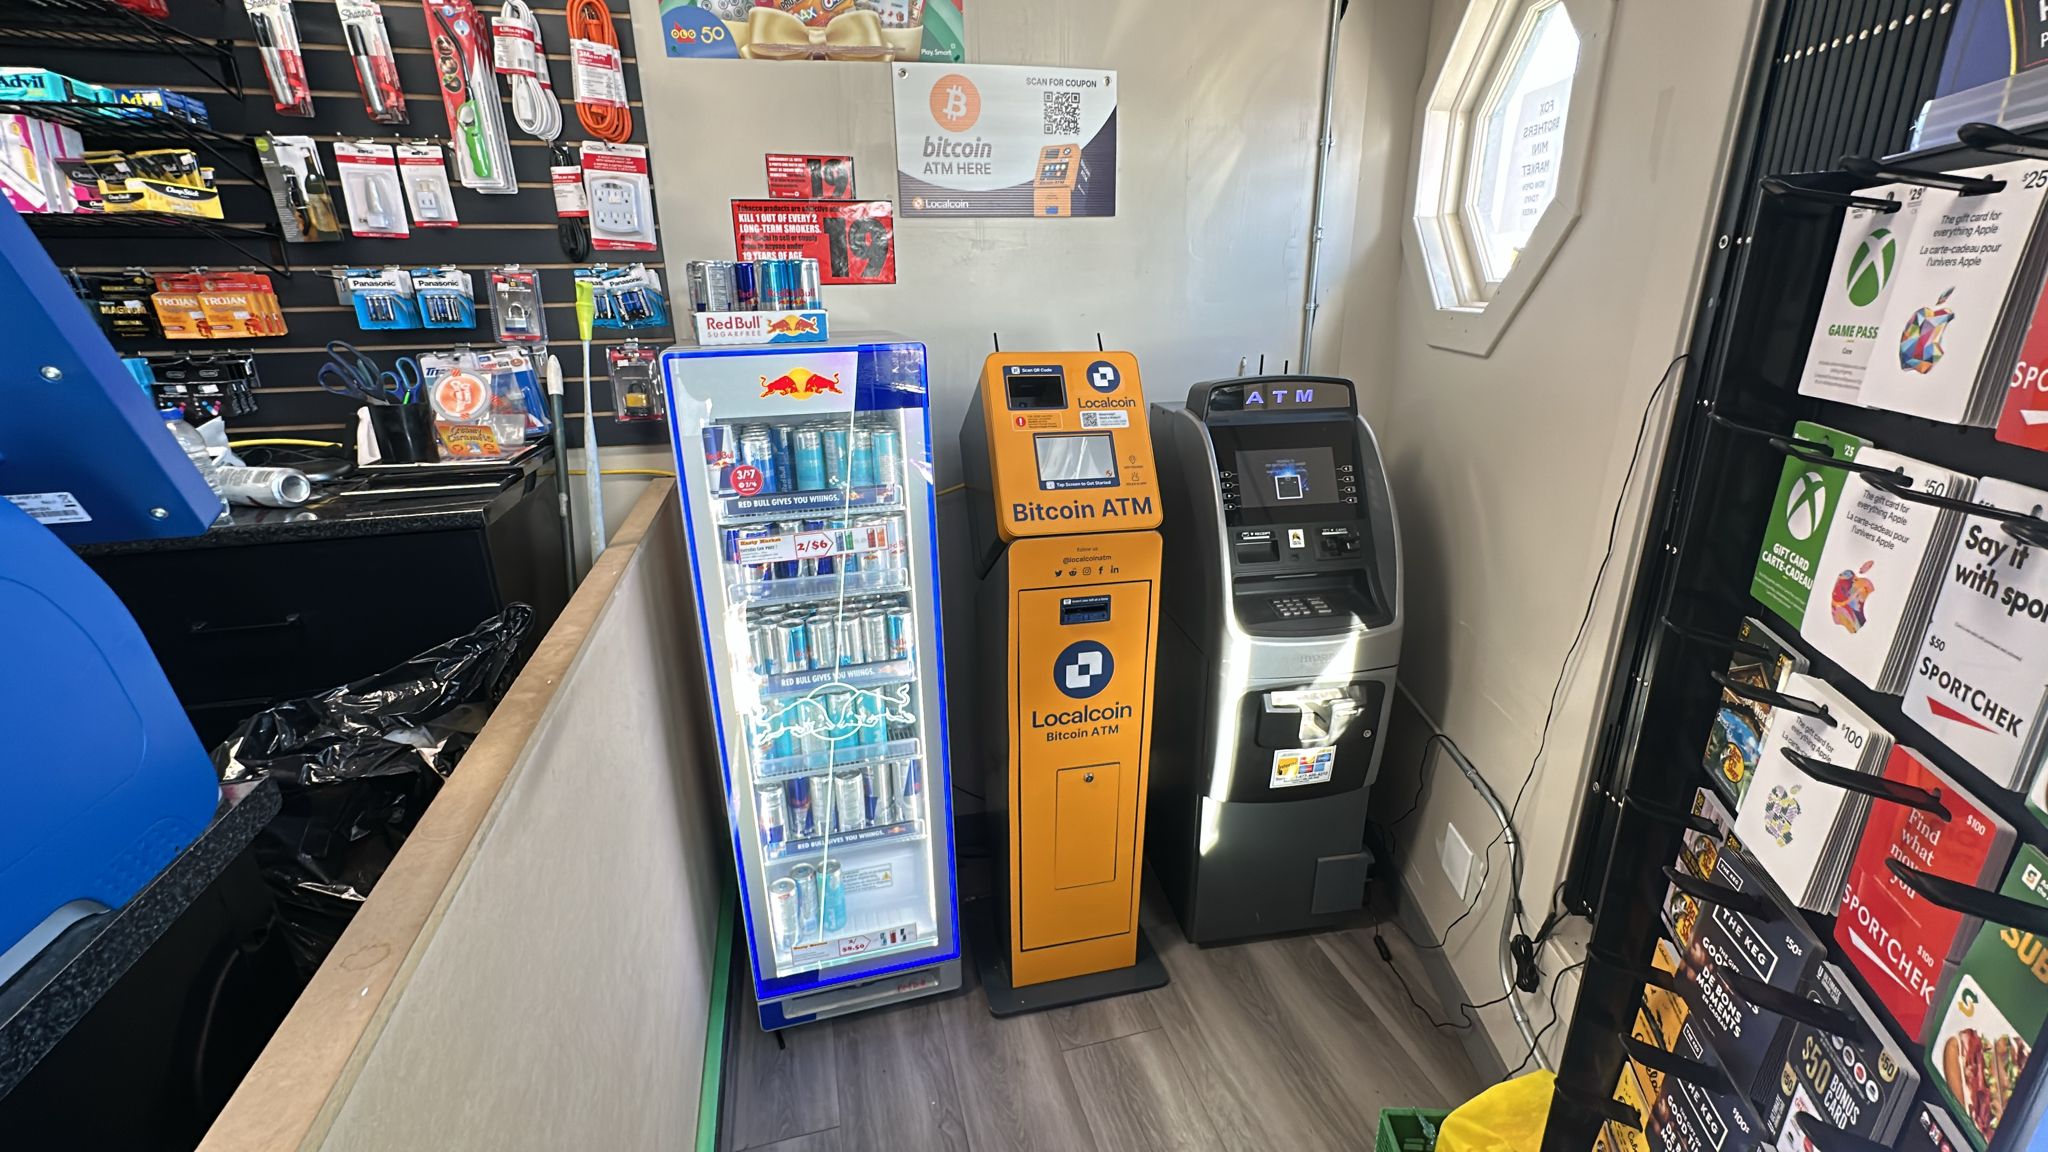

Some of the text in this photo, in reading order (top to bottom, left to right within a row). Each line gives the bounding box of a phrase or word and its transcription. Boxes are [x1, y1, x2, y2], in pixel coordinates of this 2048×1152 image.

[671, 29, 697, 40] OLG
[700, 26, 725, 44] 50
[0, 75, 45, 89] Advil
[1026, 77, 1097, 88] SCAN FOR COUPON
[922, 136, 992, 158] bitcoin
[806, 158, 849, 198] 19
[923, 162, 992, 175] ATM HERE
[2022, 170, 2048, 190] $25
[165, 186, 200, 197] ChapStick
[925, 199, 969, 209] Localcoin
[738, 214, 817, 223] KILL 1 OUT OF EVERY 2
[1941, 211, 2002, 226] The gift card for
[739, 224, 821, 234] LONG-TERM SMOKERS.
[1933, 225, 1999, 238] everything Apple
[742, 252, 752, 260] 19
[752, 252, 776, 260] YEARS
[823, 217, 888, 278] 19
[1920, 244, 2002, 256] La carte-cadeau pour
[1958, 256, 1982, 267] Apple
[352, 279, 397, 288] Panasonic
[418, 279, 460, 288] Panasonic
[609, 276, 643, 287] Panasonic
[158, 297, 198, 306] TROJAN
[203, 297, 246, 306] TROJAN
[707, 316, 760, 330] Red Bull
[1828, 325, 1879, 340] GAME PASS
[1078, 396, 1136, 409] Localcoin
[1246, 389, 1314, 405] ATM
[1925, 479, 1945, 497] $50
[738, 500, 752, 509] RED
[753, 499, 770, 507] BULL
[771, 498, 792, 506] GIVES
[793, 497, 808, 505] YOU
[1012, 496, 1153, 522] Bitcoin ATM
[1863, 489, 1911, 513] The gift card for
[1857, 501, 1908, 526] everything Apple
[1846, 510, 1910, 544] La carte-cadeau pour
[796, 540, 828, 552] 2/$6
[1876, 535, 1895, 550] Apple
[1965, 525, 2030, 570] Say it
[1062, 554, 1112, 565] @localcoinatm
[1773, 543, 1810, 571] GIFT CARD
[1761, 550, 1814, 591] CARTE-CADEAU
[1956, 563, 1999, 599] with
[1928, 634, 1946, 652] $50
[781, 678, 794, 686] RED
[795, 676, 811, 685] BULL
[812, 674, 832, 683] GIVES
[1919, 656, 2024, 738] SPORTCHEK
[1032, 701, 1132, 728] Localcoin
[1046, 724, 1119, 742] Bitcoin ATM
[1781, 730, 1788, 741] La
[1796, 715, 1805, 728] The
[1814, 733, 1826, 747] card
[1826, 742, 1834, 754] for
[1841, 723, 1863, 749] $100
[1791, 725, 1832, 764] everything Apple
[1908, 807, 1941, 846] Find
[1966, 814, 1986, 836] $100
[797, 842, 809, 850] RED
[1901, 828, 1935, 867] what
[1722, 908, 1767, 966] THE KEG
[1842, 883, 1936, 1005] SPORTCHEK
[1719, 946, 1740, 974] THE GIFT
[1917, 945, 1935, 968] $100
[1695, 972, 1741, 1038] MOMENTS
[1702, 966, 1742, 1024] DE BONS
[1708, 1004, 1728, 1032] CADEAU
[1802, 1035, 1832, 1095] $50
[1880, 1052, 1895, 1078] $50
[1688, 1082, 1719, 1135] HE KEG
[1823, 1089, 1848, 1130] CARD
[1829, 1073, 1860, 1126] BONUS
[1667, 1094, 1688, 1135] GOOD
[1665, 1123, 1677, 1144] DE
